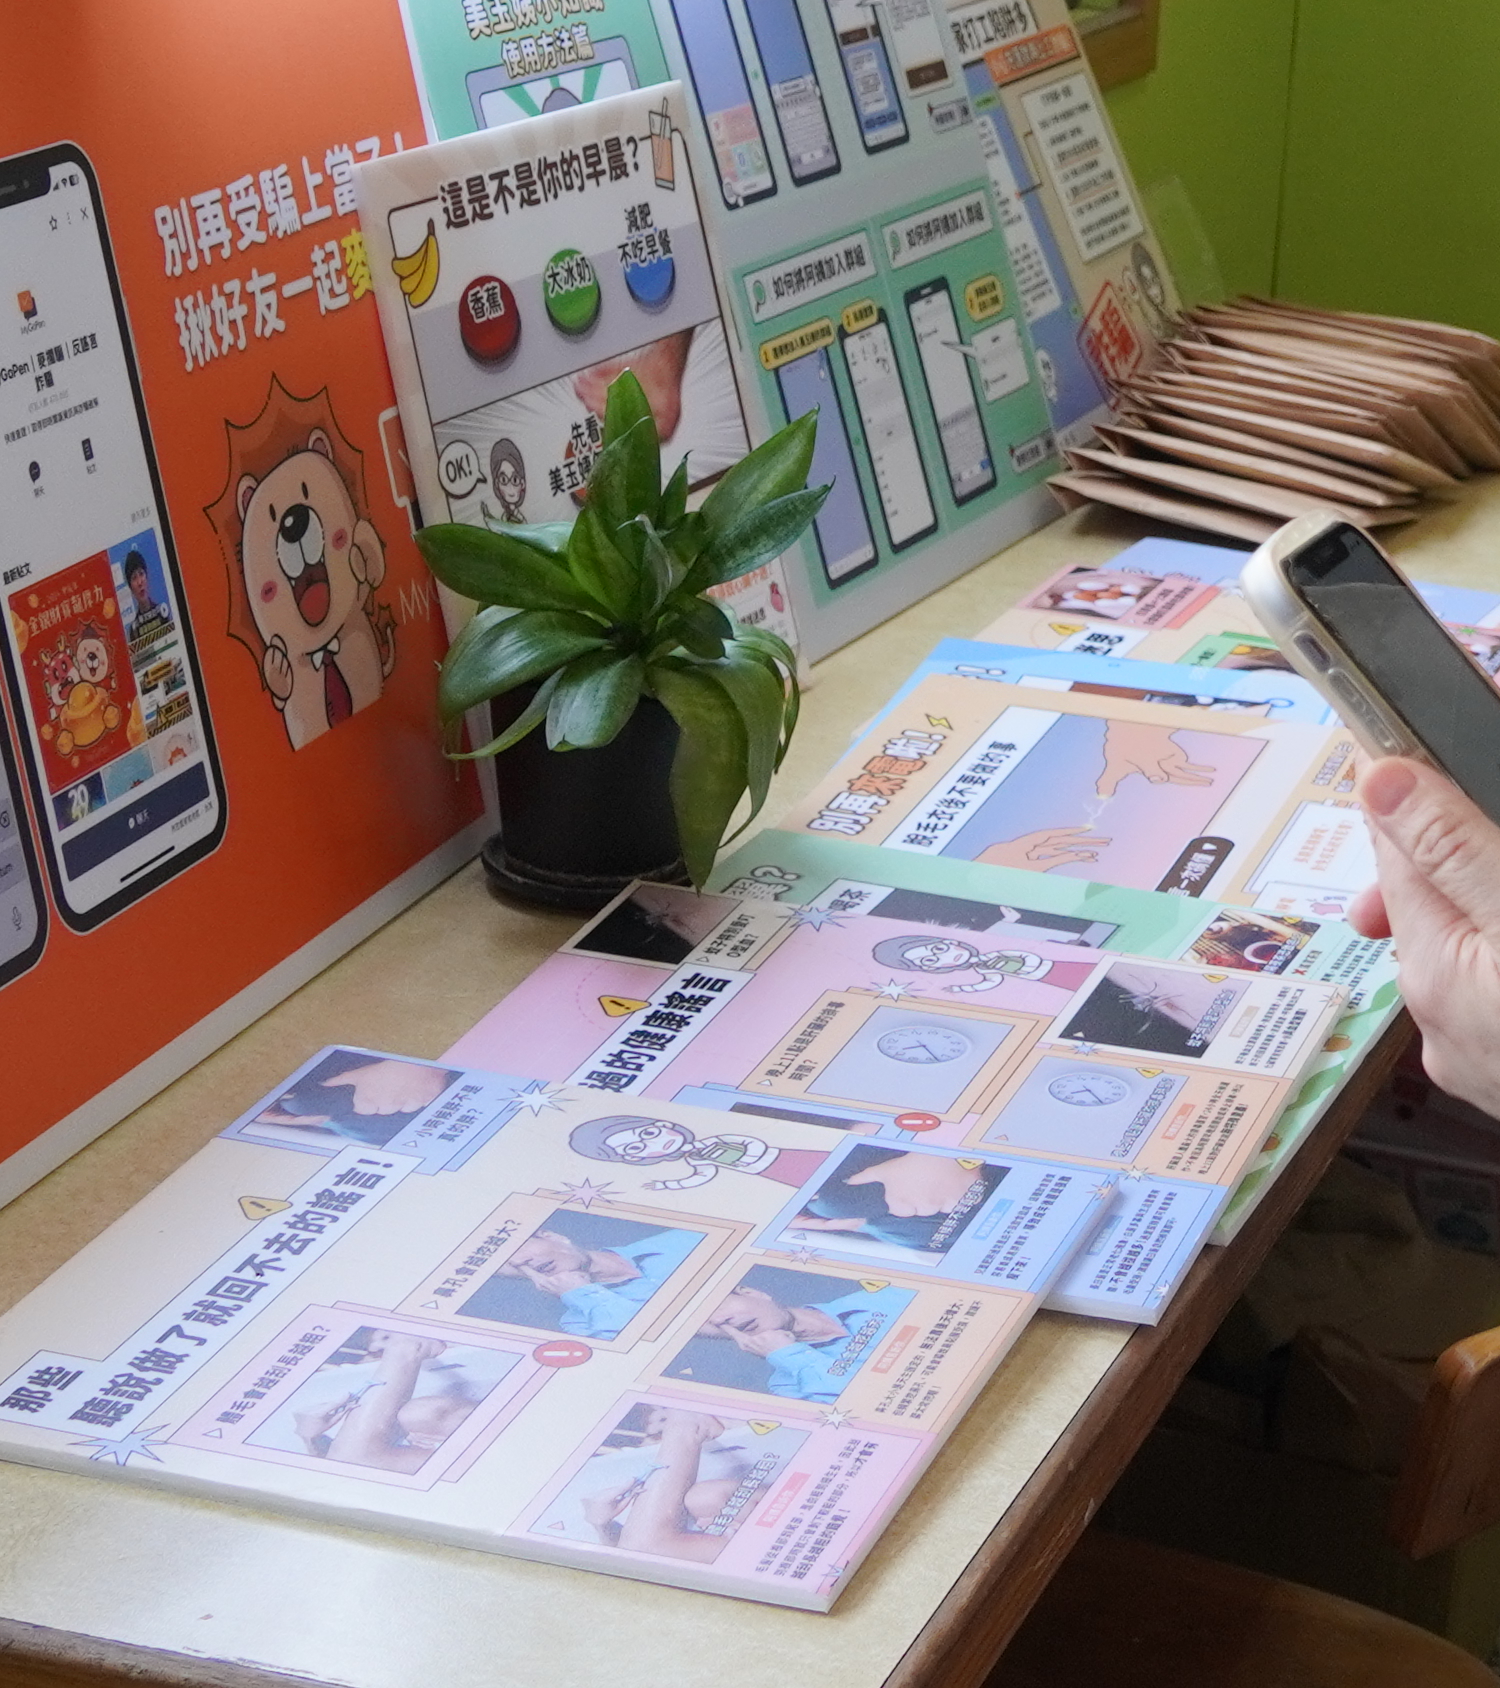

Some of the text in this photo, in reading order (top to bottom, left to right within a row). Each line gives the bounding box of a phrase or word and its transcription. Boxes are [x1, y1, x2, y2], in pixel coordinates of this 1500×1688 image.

[501, 23, 595, 79] 使用方法篇
[548, 256, 591, 294] 大冰奶
[618, 228, 672, 268] 不吃早餐
[468, 284, 502, 321] 香蕉
[446, 455, 473, 482] OK!
[807, 729, 947, 836] 別再來電啦!
[902, 741, 1018, 848] 脫毛衣後不要做的事
[409, 1083, 485, 1139] 小時候胖不是
[67, 1156, 402, 1429] 聽說做了就回不去的謠言!
